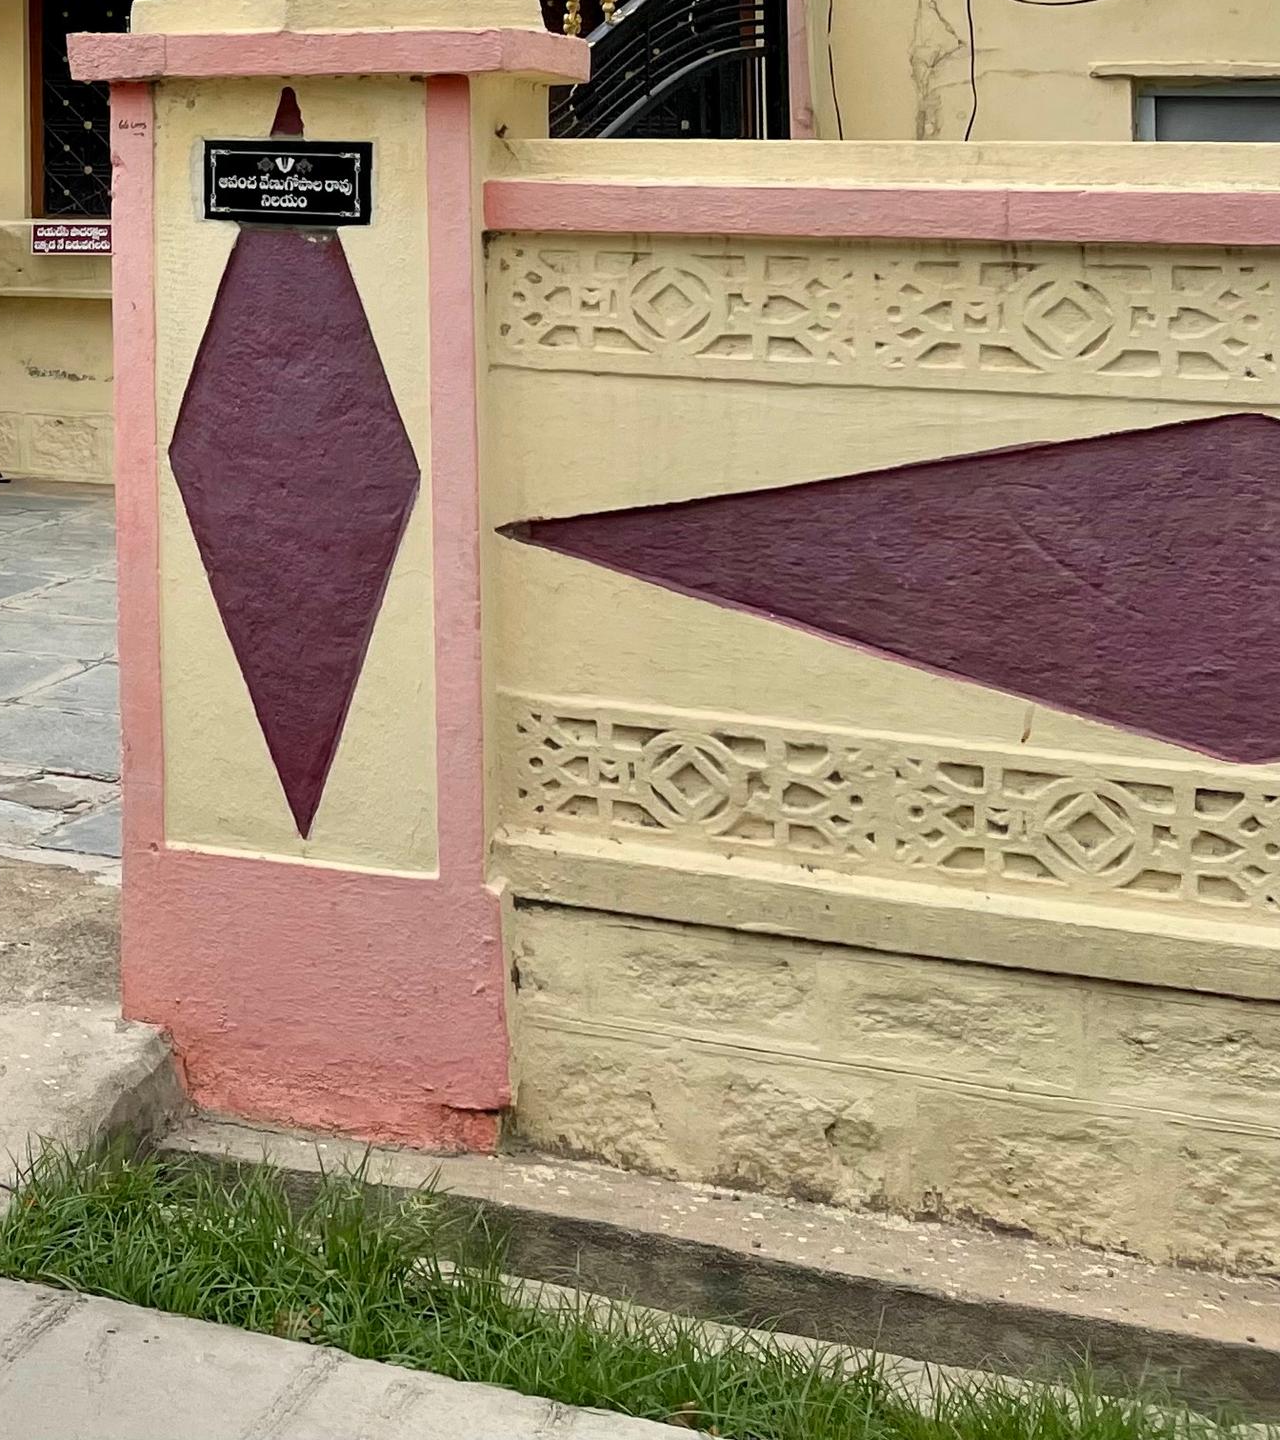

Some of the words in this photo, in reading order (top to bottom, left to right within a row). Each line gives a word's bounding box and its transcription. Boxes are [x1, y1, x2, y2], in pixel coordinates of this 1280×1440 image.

[219, 175, 257, 189] ఆవంచ
[259, 173, 323, 191] వేణుగోపాల
[325, 179, 352, 195] రావు
[261, 194, 308, 208] నిలయం
